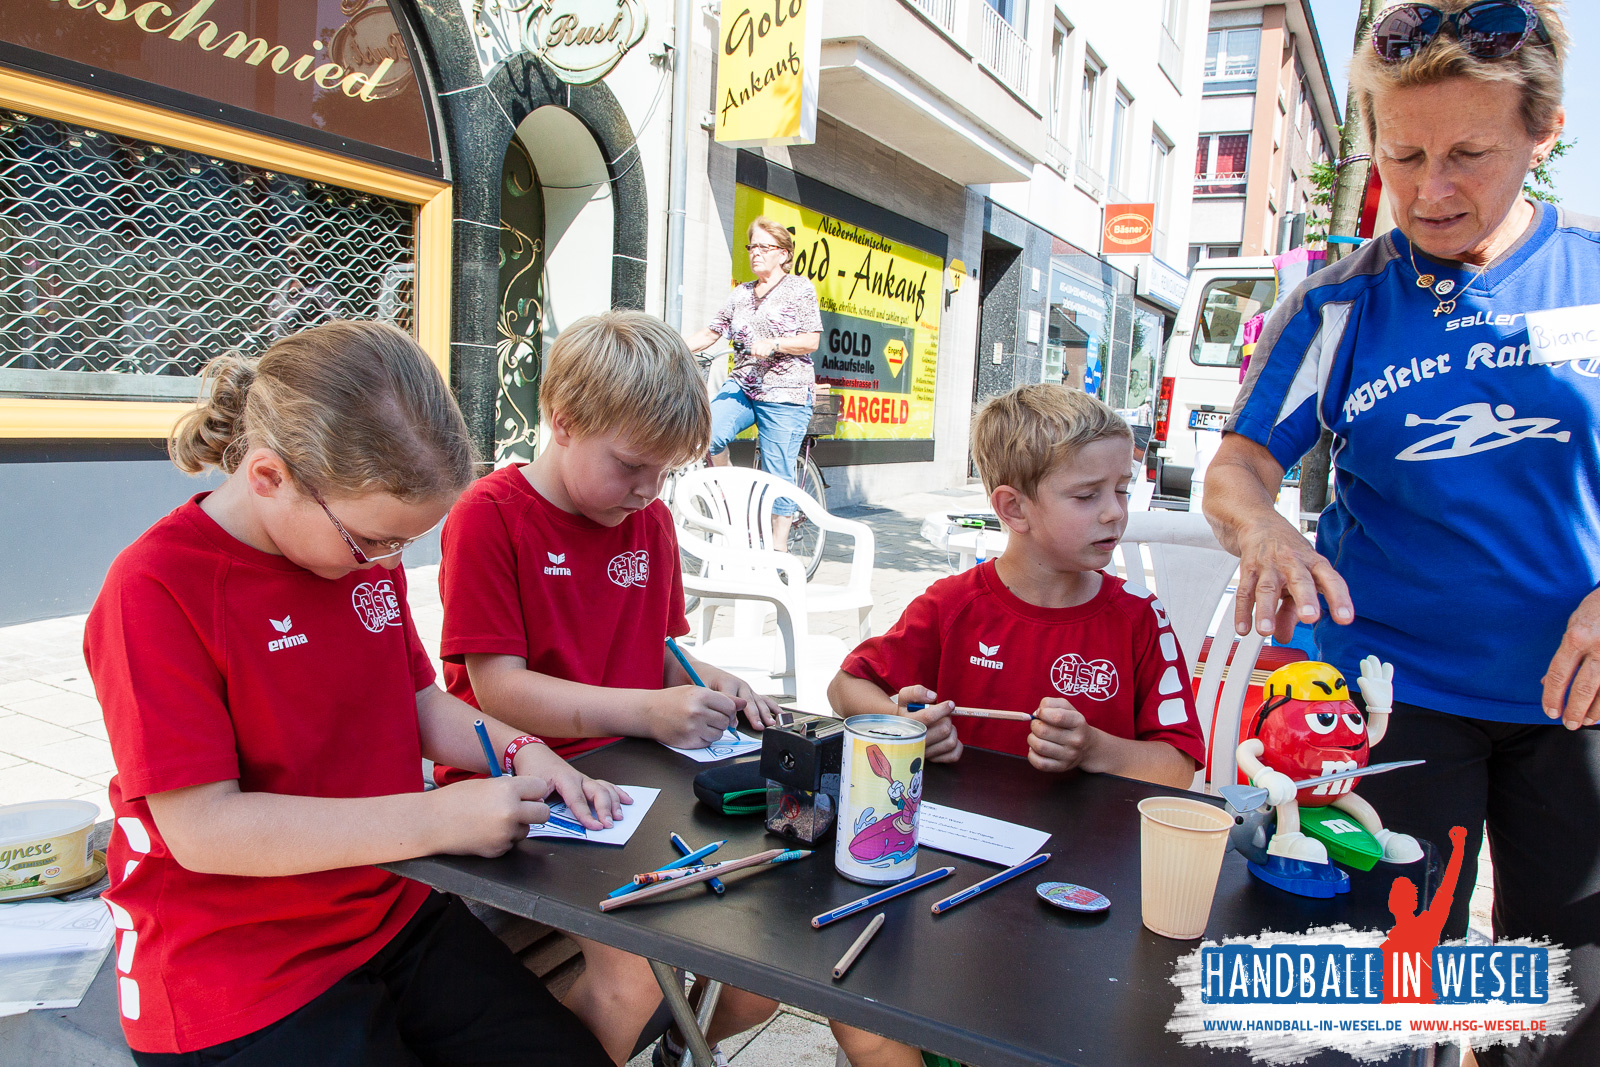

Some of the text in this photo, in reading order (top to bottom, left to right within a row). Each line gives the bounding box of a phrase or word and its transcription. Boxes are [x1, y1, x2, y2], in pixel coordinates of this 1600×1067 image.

[546, 12, 625, 46] Rust
[50, 0, 395, 102] schmied
[722, 42, 800, 127] Ankauf
[817, 216, 892, 254] Niederrheinischer
[1114, 225, 1143, 234] Bäsner
[786, 227, 830, 282] old
[849, 249, 927, 322] Ankauf
[1445, 311, 1524, 331] saller
[829, 328, 871, 357] GOLD
[888, 346, 902, 356] Eingang
[822, 355, 875, 375] Ankaufstelle
[872, 379, 879, 390] 11
[837, 394, 909, 424] BARGELD
[543, 566, 572, 576] erima
[267, 630, 309, 652] erima
[969, 655, 1003, 670] erima
[1060, 662, 1112, 688] HSG
[1063, 681, 1102, 694] WESEL
